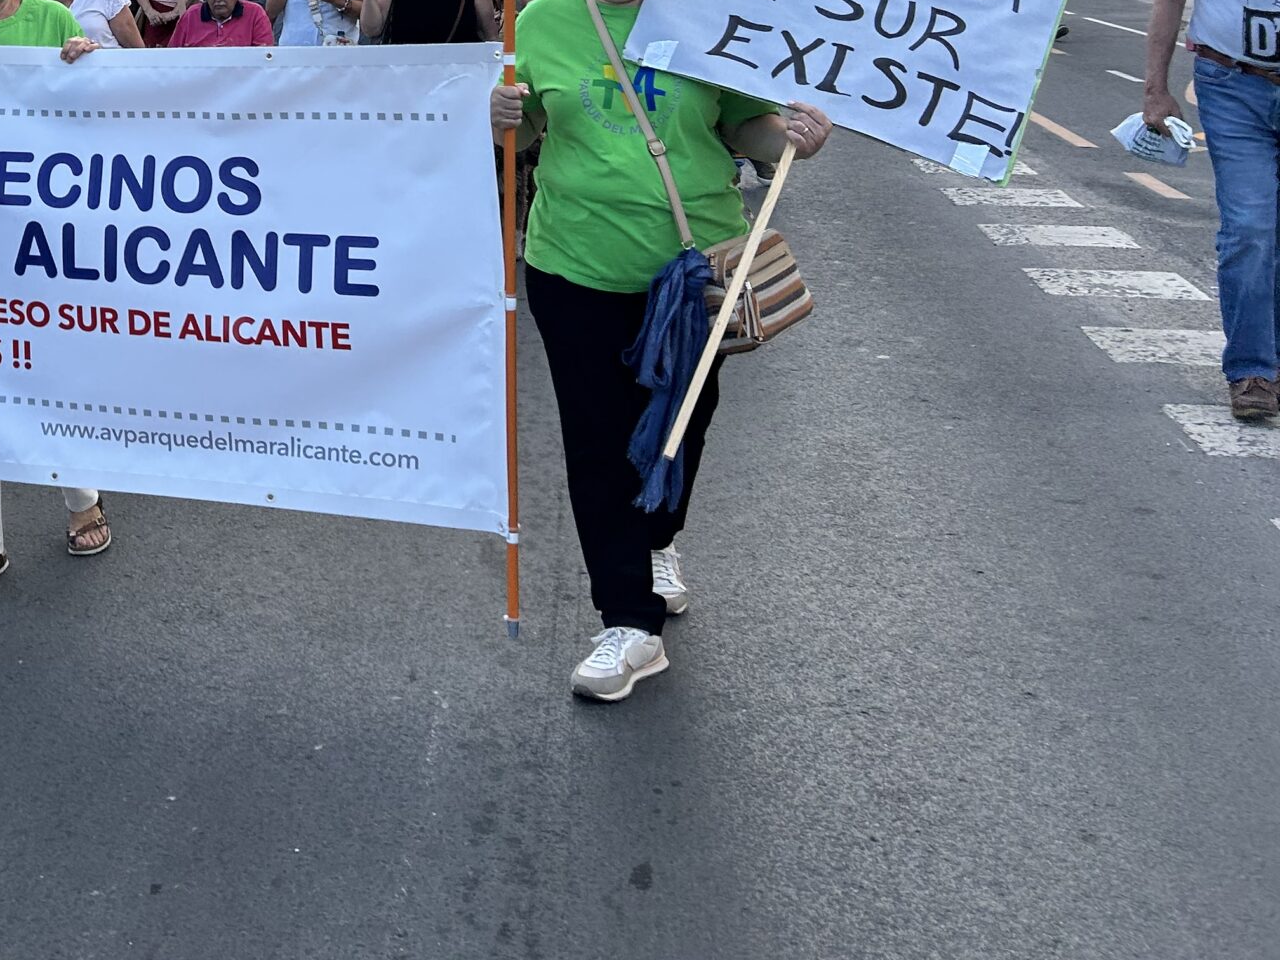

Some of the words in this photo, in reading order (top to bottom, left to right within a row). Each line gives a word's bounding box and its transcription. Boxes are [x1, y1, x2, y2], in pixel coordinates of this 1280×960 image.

[579, 78, 603, 122] PARQUE
[602, 119, 625, 135] DEL
[629, 122, 657, 135] MR
[706, 14, 1025, 159] EXISTE!
[14, 221, 380, 297] ALICANTE
[58, 304, 118, 334] SUR
[127, 309, 171, 338] DE
[179, 313, 351, 350] ALICANTE
[12, 340, 32, 370] !!
[41, 421, 419, 471] www.avparquedelmaralicante.com
